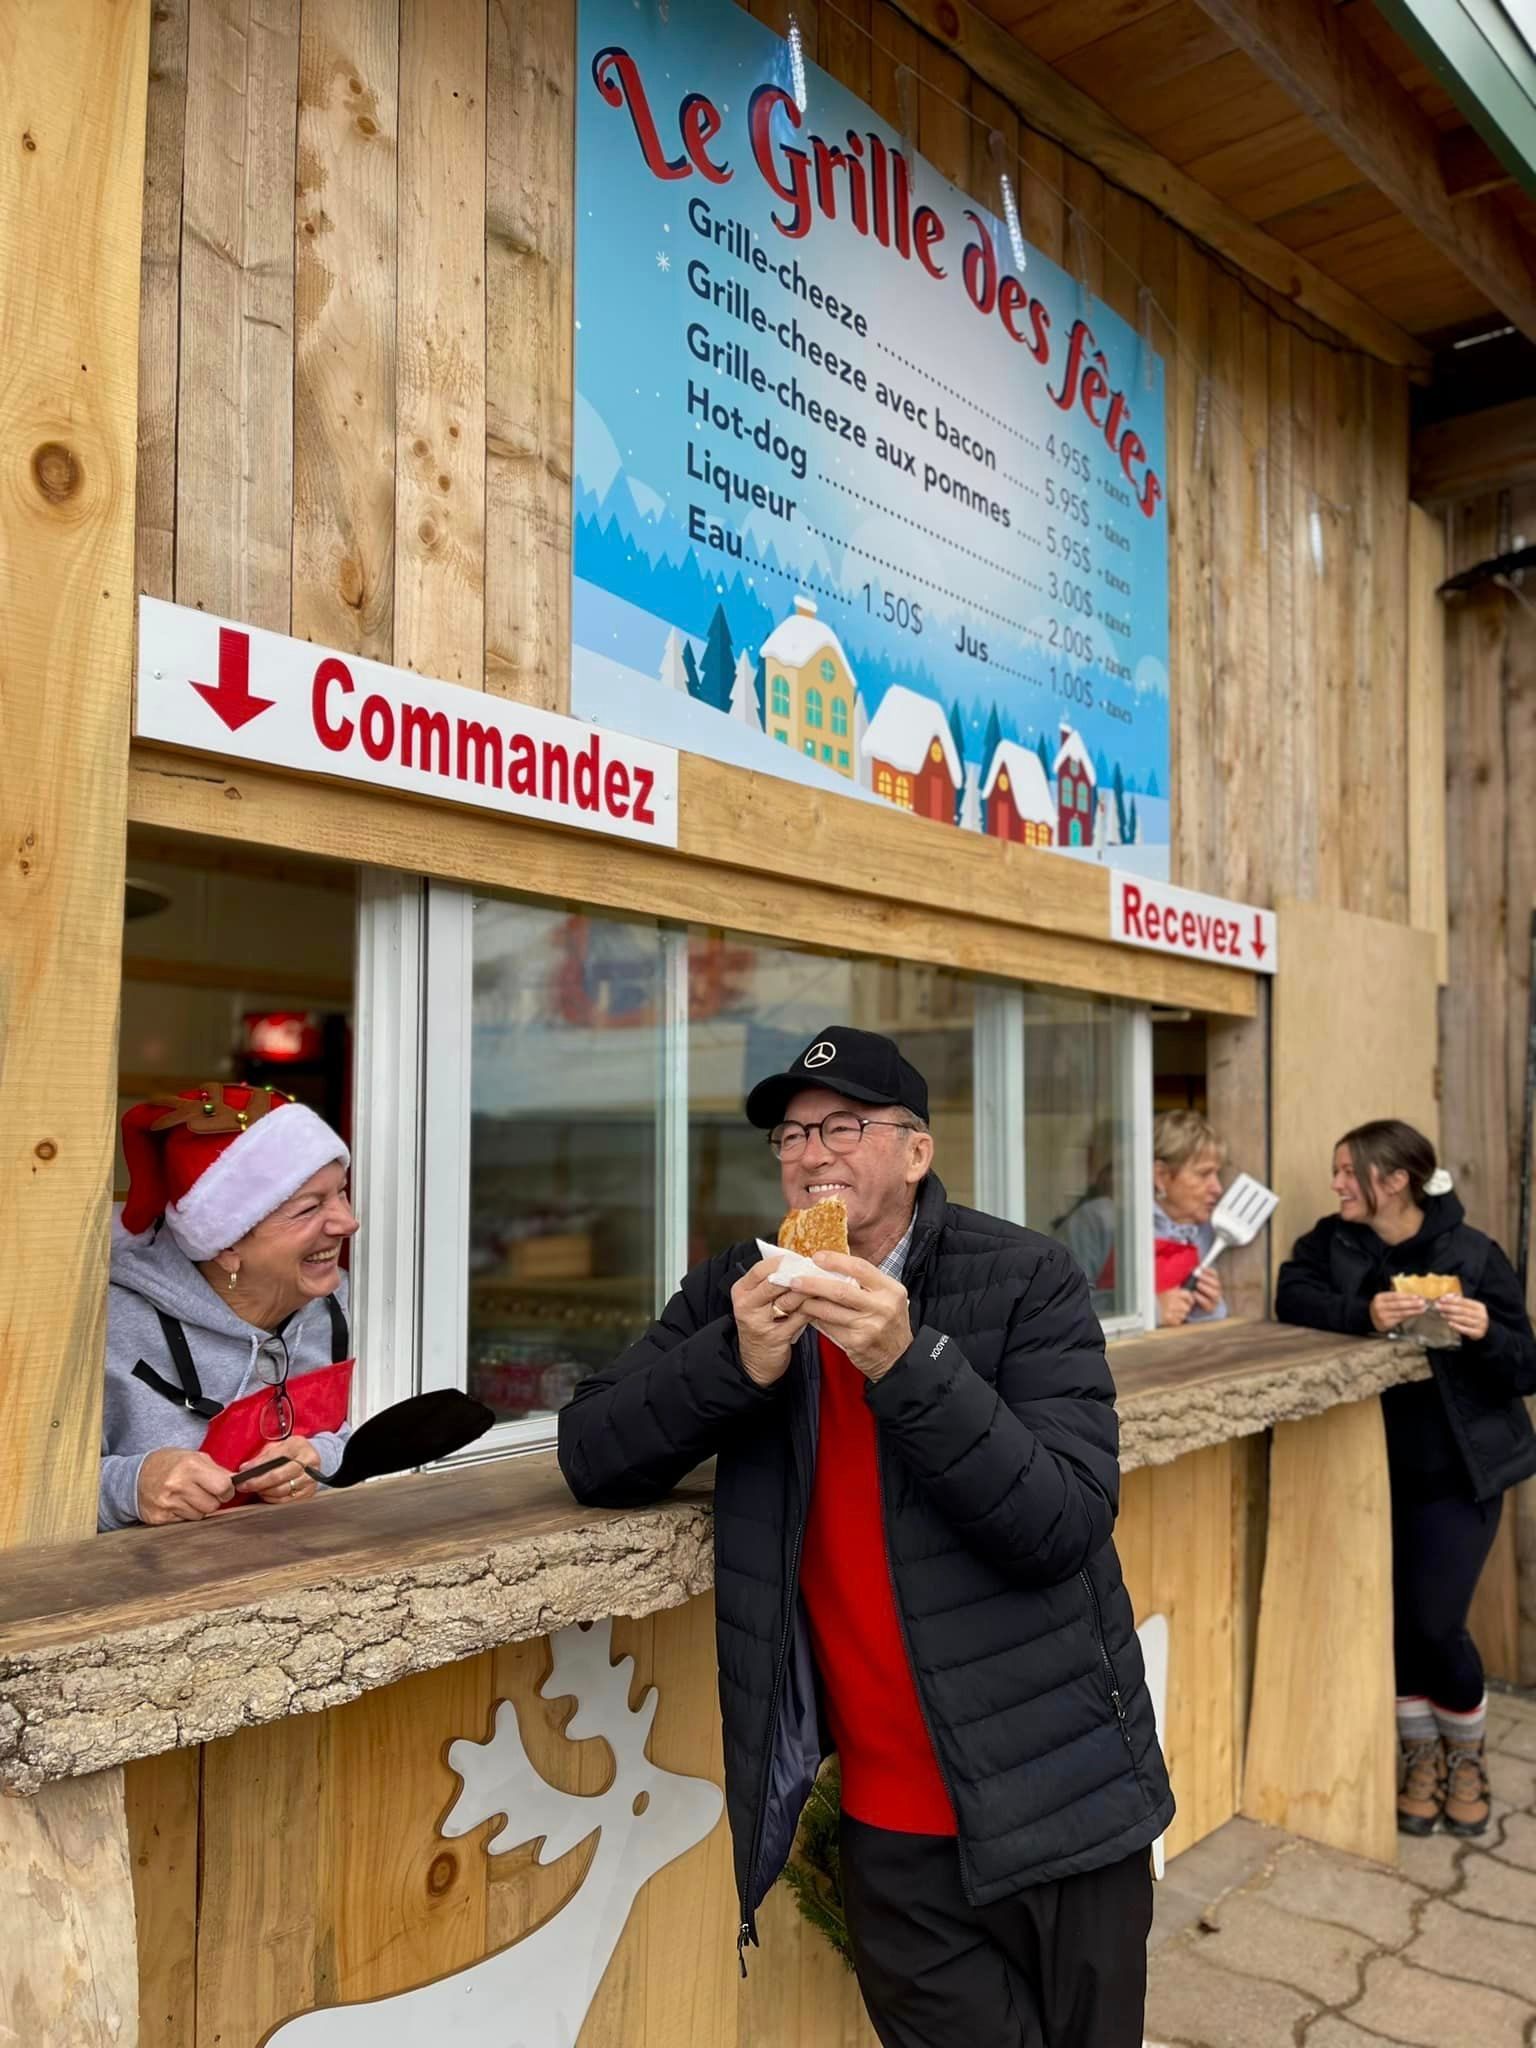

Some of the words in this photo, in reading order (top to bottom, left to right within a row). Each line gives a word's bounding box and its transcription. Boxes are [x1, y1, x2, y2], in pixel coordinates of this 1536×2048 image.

[592, 46, 735, 184] Le
[748, 83, 948, 280] Grille
[963, 210, 1052, 365] des
[1046, 319, 1163, 518] fêtes
[687, 259, 867, 392] Grille-cheeze
[875, 382, 928, 430] avec
[935, 407, 997, 471] bacon
[1045, 477, 1090, 527] 5.95$
[688, 197, 868, 338] Grille-cheeze
[1046, 434, 1091, 483] 4.95$
[686, 322, 868, 448] Grille-cheeze
[875, 436, 917, 477] aux
[924, 462, 1011, 528] pommes
[1046, 525, 1092, 574] 5.95$
[687, 379, 808, 479] Hot-dog
[1048, 571, 1093, 618] 3.00$
[687, 441, 797, 522] Liqueur
[1048, 618, 1093, 663] 2.00$
[688, 503, 743, 560] Eau
[862, 582, 923, 636] 1.50$
[954, 625, 989, 664] Jus
[1049, 666, 1093, 709] 1.00$
[312, 657, 656, 825] Commandez
[1122, 883, 1242, 957] Recevez
